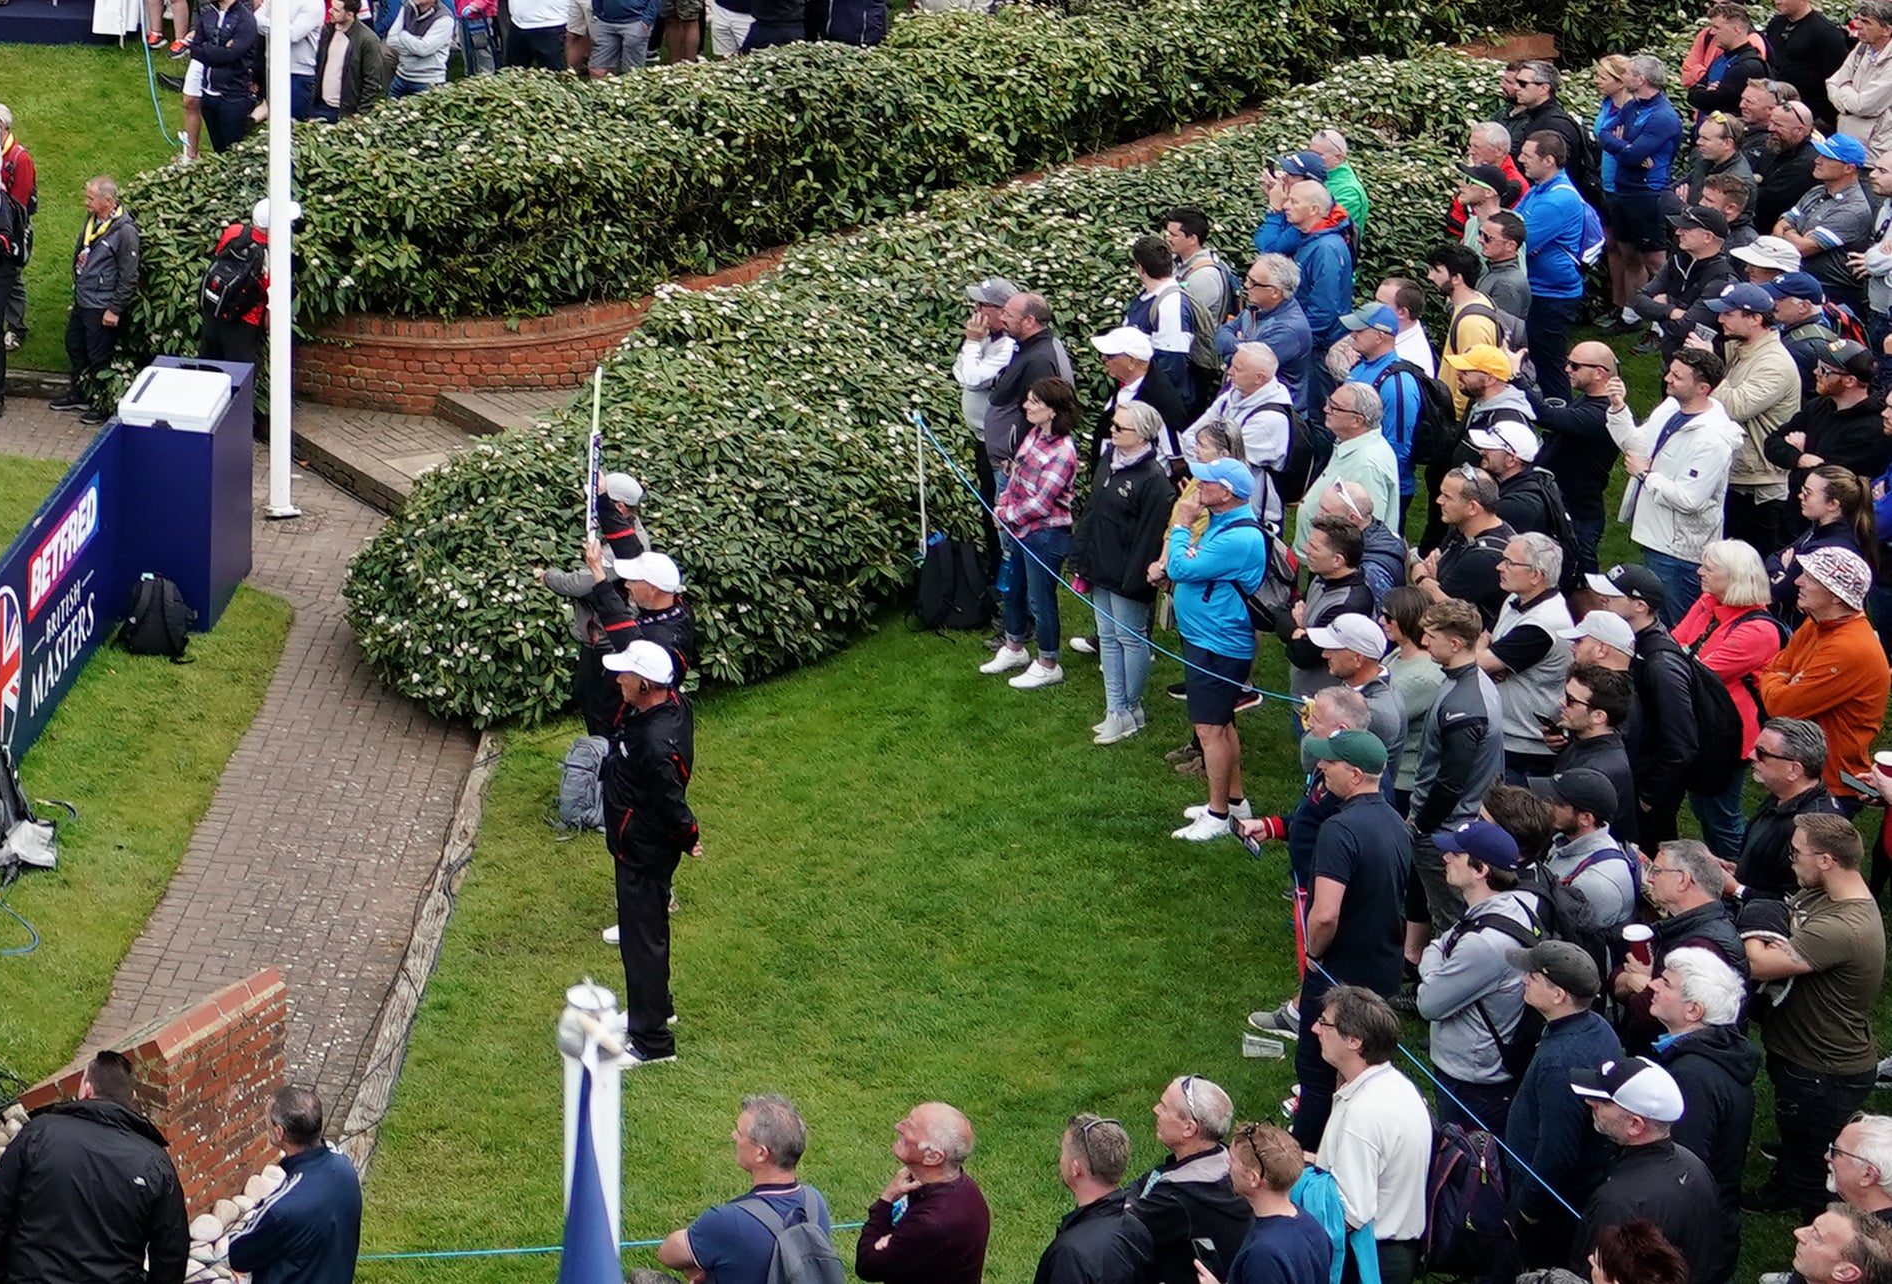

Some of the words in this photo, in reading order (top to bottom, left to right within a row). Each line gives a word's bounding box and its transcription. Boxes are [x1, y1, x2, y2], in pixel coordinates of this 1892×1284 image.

[31, 486, 98, 610] BETFRED
[30, 592, 95, 718] MASTERS
[45, 578, 81, 644] BRITISH
